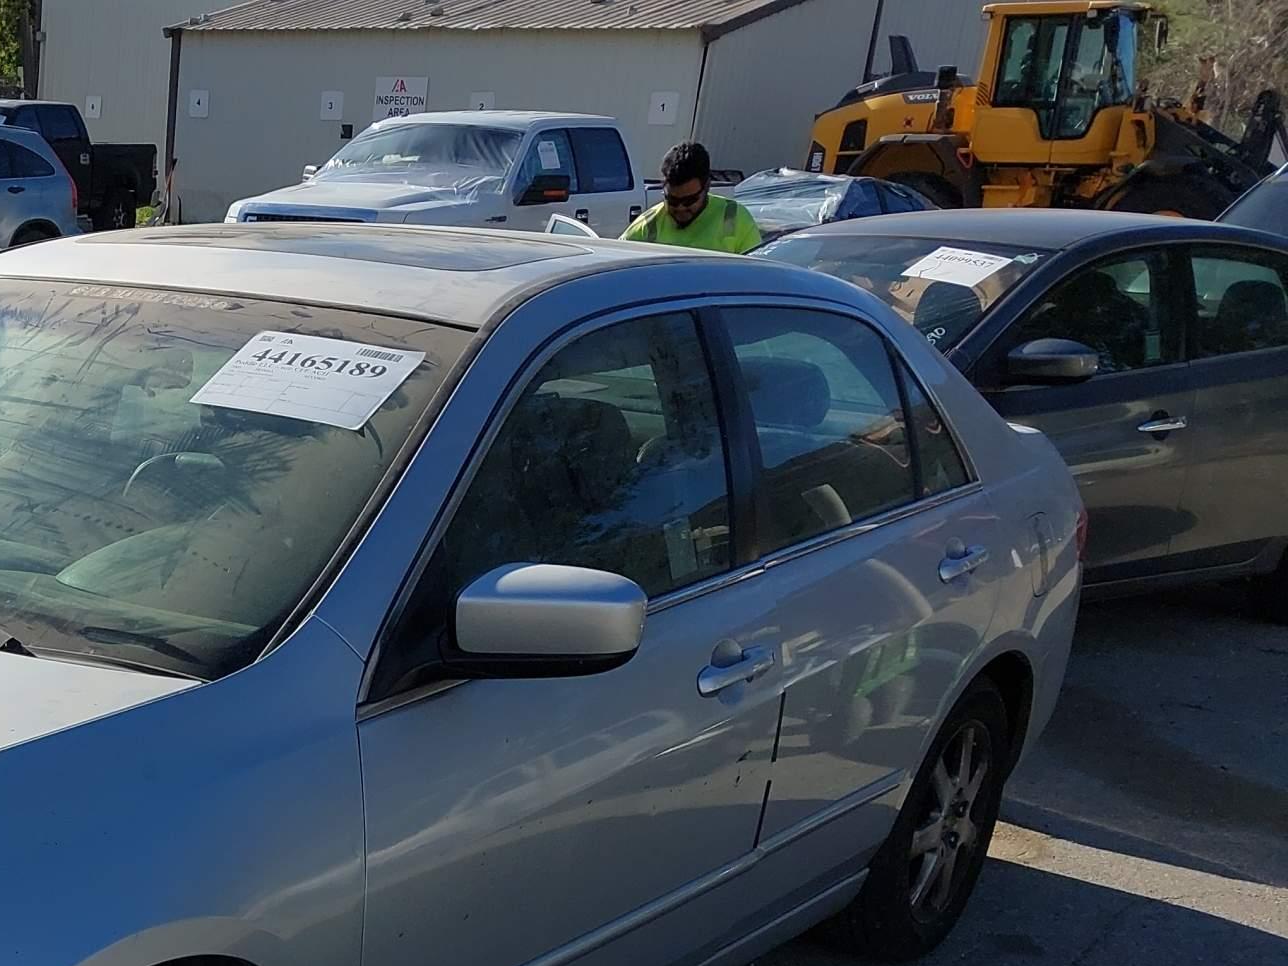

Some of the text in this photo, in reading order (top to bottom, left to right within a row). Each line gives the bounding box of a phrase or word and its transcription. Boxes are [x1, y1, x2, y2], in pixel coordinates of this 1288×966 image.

[327, 101, 333, 110] 3
[375, 95, 425, 106] INSPECTION
[479, 102, 485, 111] 2
[387, 107, 410, 117] AREA
[252, 348, 389, 379] 44165189
